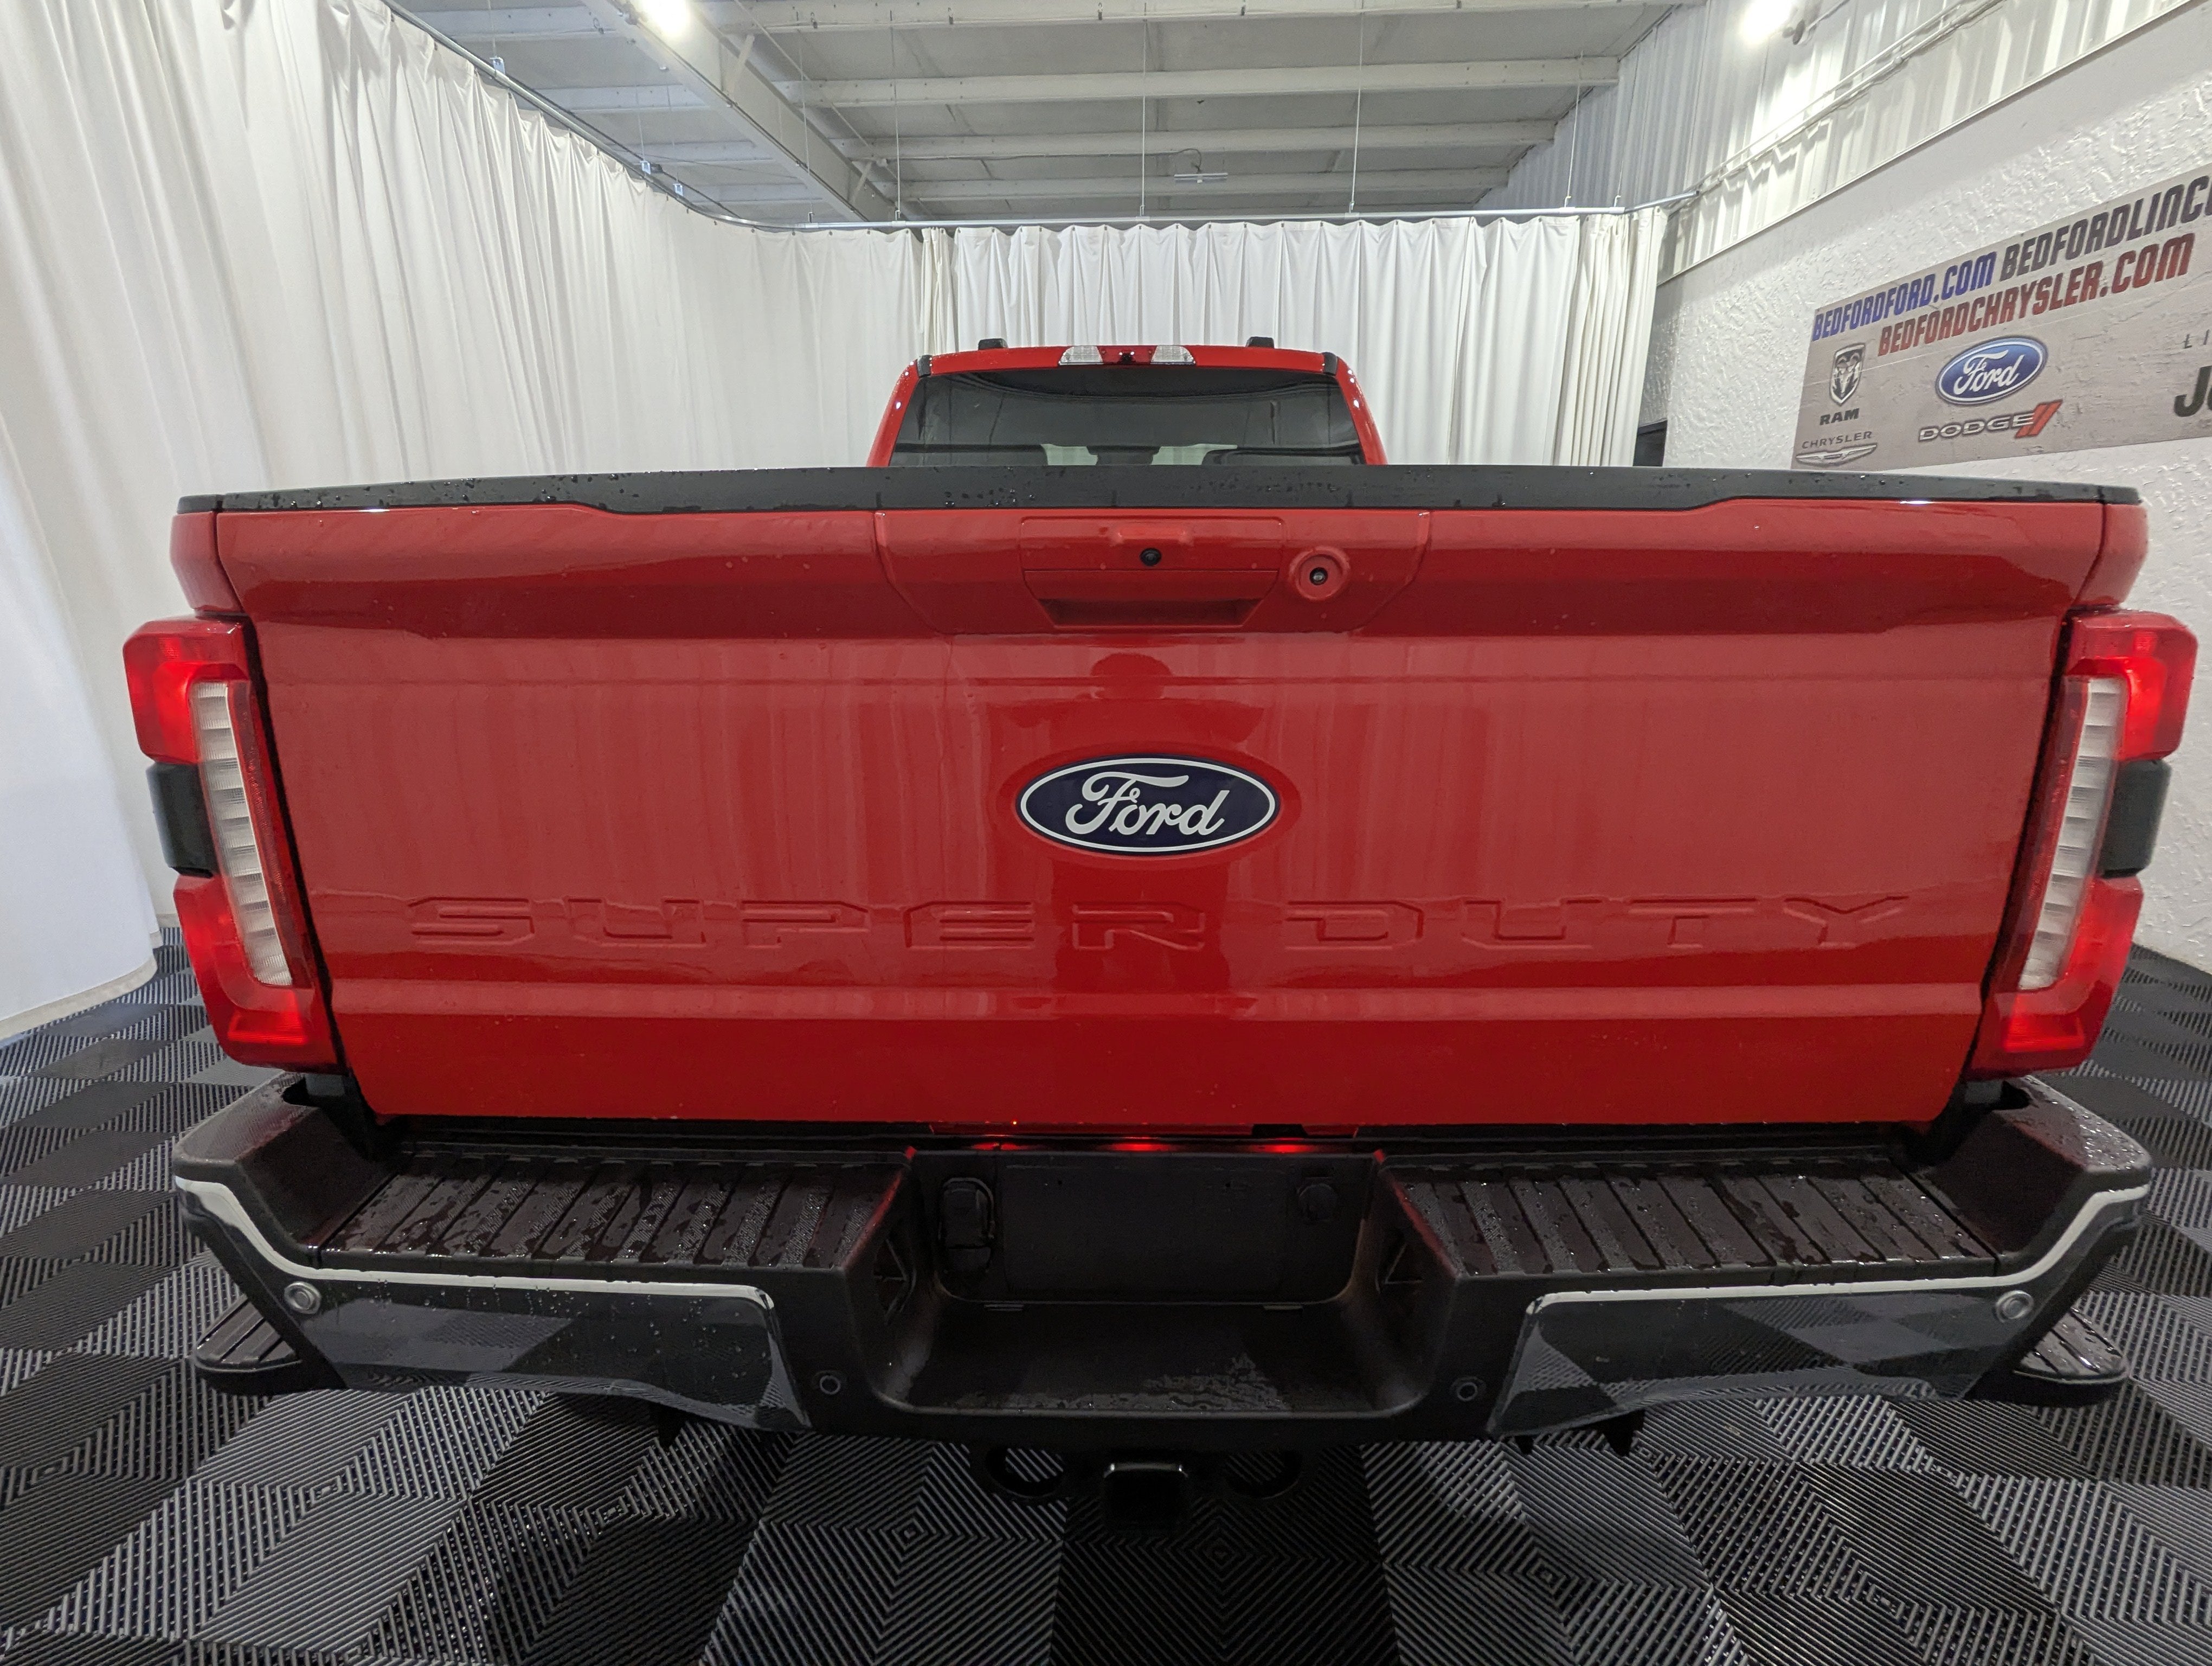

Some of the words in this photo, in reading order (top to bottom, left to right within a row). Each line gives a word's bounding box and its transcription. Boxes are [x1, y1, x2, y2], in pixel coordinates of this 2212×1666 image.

[1812, 251, 1997, 341] BEDFORDFORD.COM
[1878, 233, 2195, 356] BEDFORDCHRYSLER.COM
[1953, 350, 2024, 394] Ford
[2174, 366, 2212, 417] J
[1802, 431, 1872, 449] CHRYSLER
[1819, 408, 1860, 426] RAM
[1919, 413, 2034, 441] DODGE
[1065, 771, 1230, 835] Ford
[407, 896, 1207, 951] SUPER
[1285, 896, 1909, 951] DUTY
